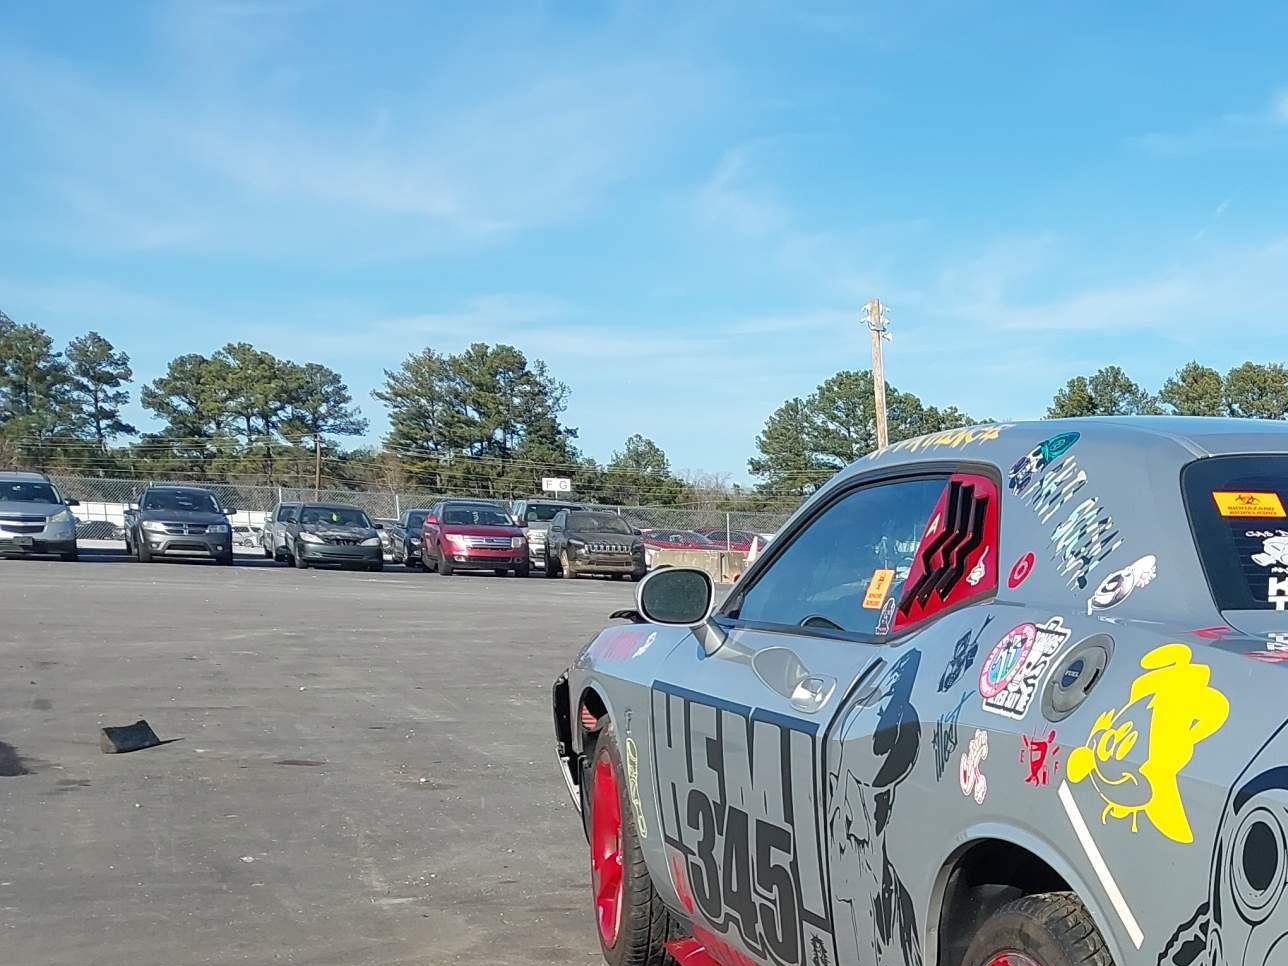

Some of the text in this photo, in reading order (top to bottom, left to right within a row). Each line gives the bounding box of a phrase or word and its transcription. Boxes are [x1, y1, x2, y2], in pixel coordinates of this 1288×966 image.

[546, 480, 567, 489] F G
[1065, 670, 1080, 678] FUEL
[651, 680, 832, 930] HEMI
